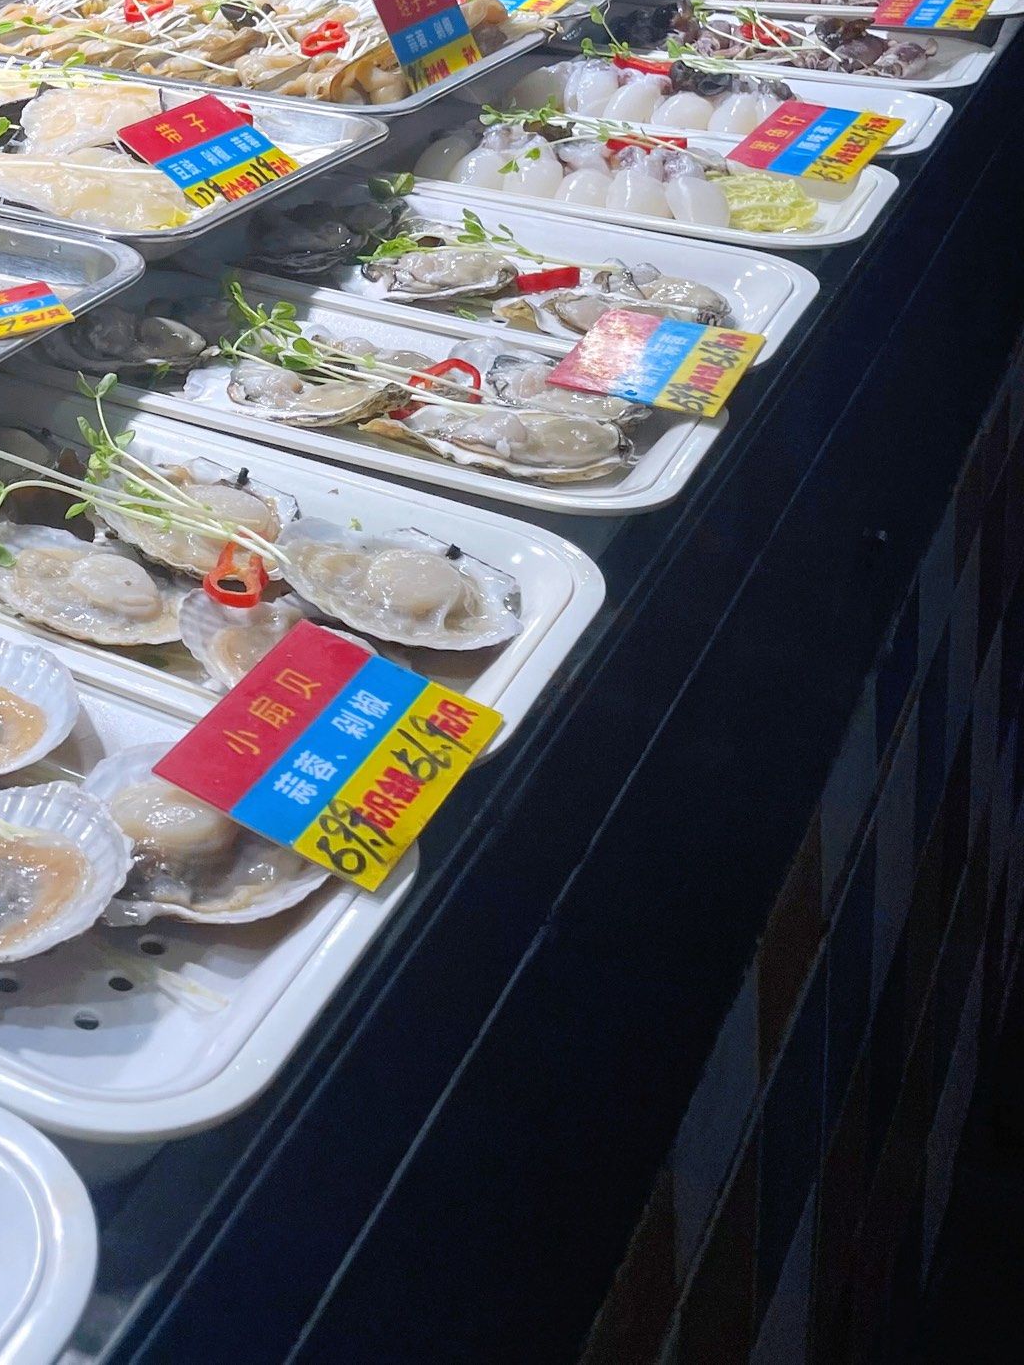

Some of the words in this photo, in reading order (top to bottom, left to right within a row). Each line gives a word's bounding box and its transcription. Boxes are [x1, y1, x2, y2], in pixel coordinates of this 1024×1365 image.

[155, 113, 207, 145] 带子
[750, 115, 806, 152] 墨鱼仔
[168, 132, 262, 181] 豆豉、剁椒、蒜蓉
[222, 667, 322, 756] 小扇贝
[272, 689, 393, 805] 蒜蓉、剁椒
